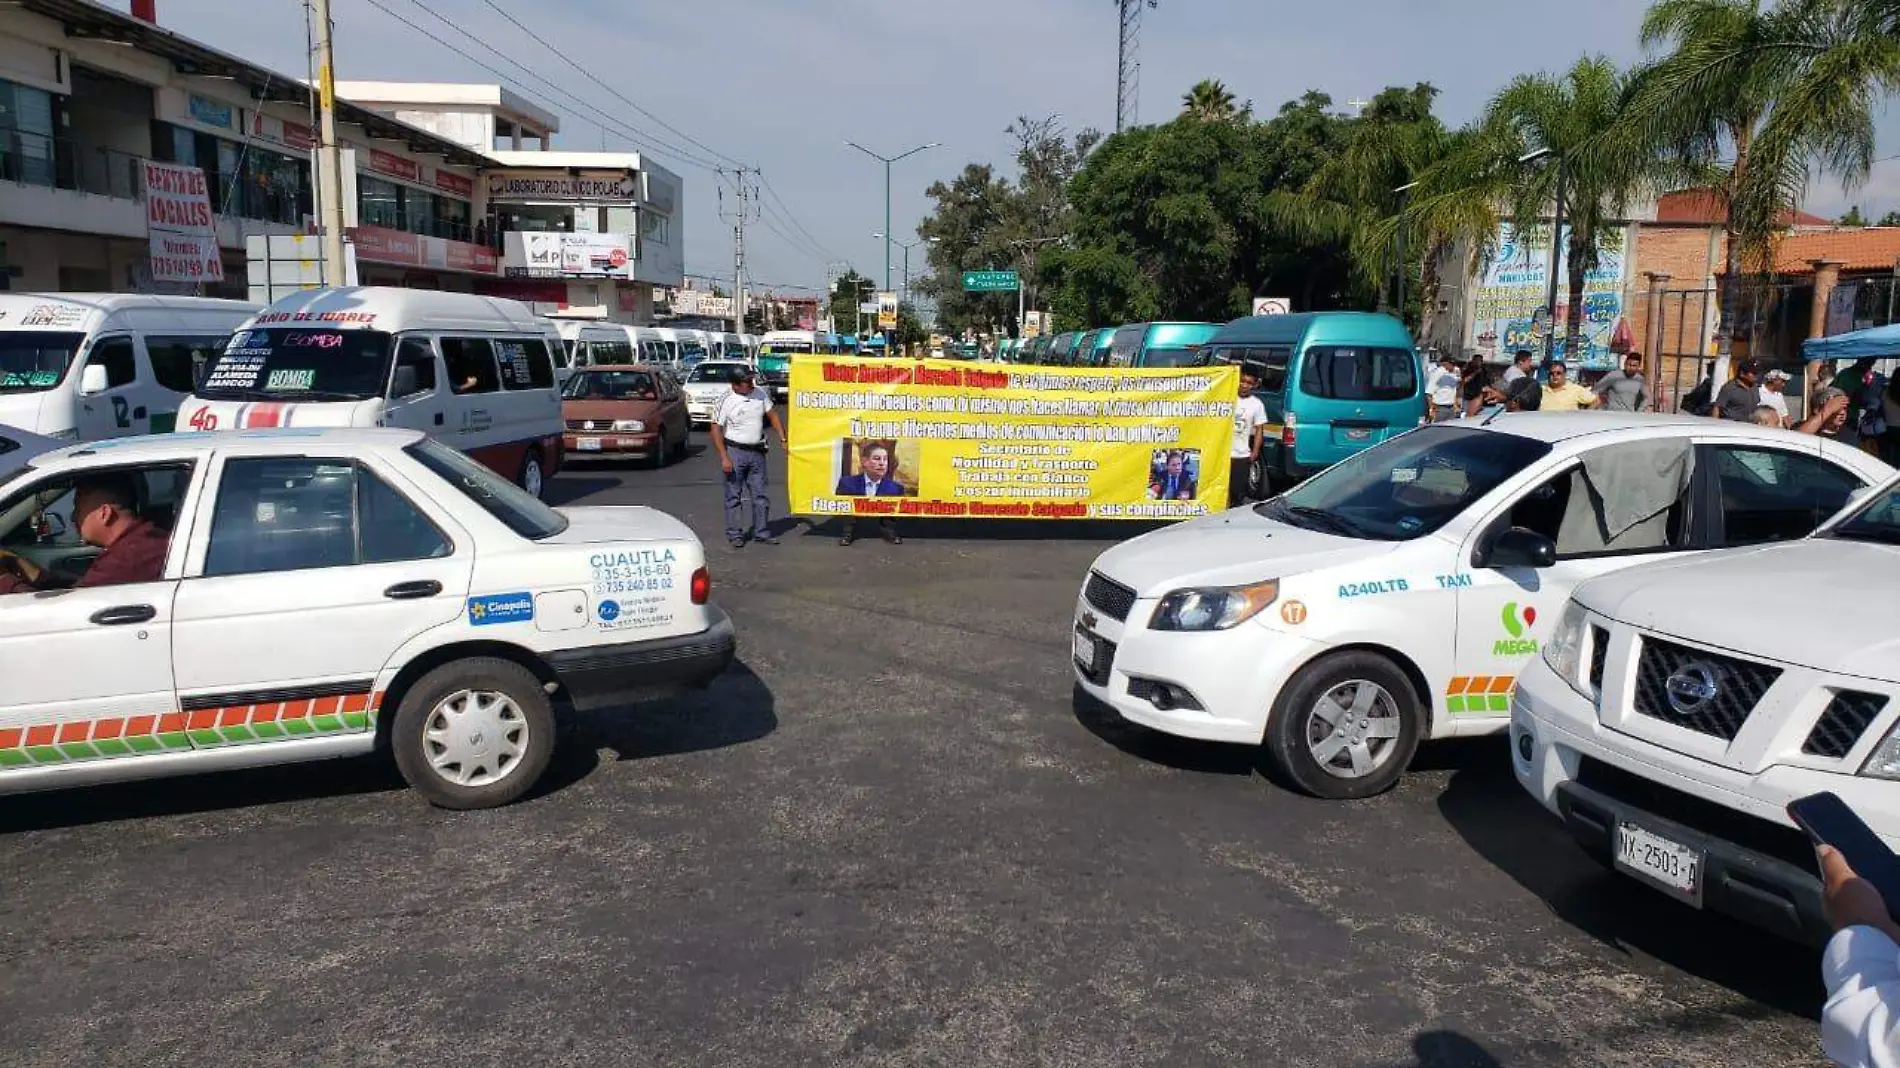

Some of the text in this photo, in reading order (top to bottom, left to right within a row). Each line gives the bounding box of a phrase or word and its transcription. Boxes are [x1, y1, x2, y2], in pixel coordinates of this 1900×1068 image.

[188, 172, 206, 195] DE
[504, 180, 559, 195] LABORATORIO
[150, 195, 209, 226] LOCALES
[292, 312, 313, 322] DE
[210, 371, 258, 379] ALAMEDA
[267, 369, 316, 388] BOMBA
[951, 456, 1018, 469] Movilidad
[811, 497, 851, 513] Fuera
[590, 548, 676, 568] CUAUTLA
[606, 581, 624, 593] 735
[1338, 573, 1472, 598] A240LTB TAXI
[1286, 603, 1302, 622] 17
[1492, 638, 1539, 657] MEGA
[1619, 830, 1697, 887] NX-2503-A
